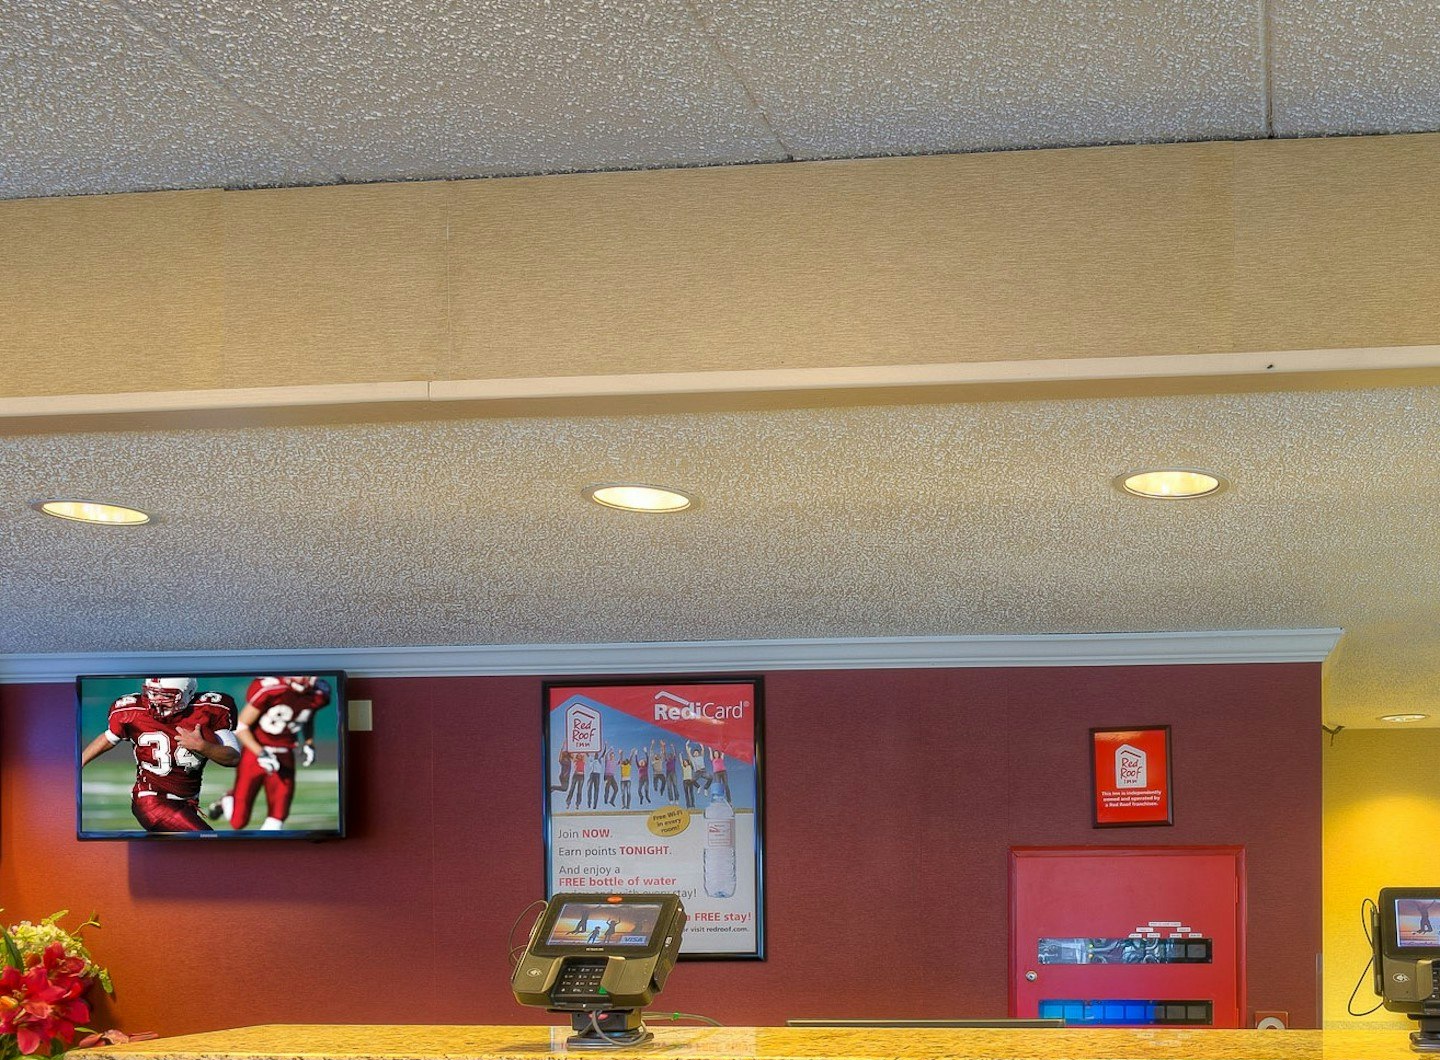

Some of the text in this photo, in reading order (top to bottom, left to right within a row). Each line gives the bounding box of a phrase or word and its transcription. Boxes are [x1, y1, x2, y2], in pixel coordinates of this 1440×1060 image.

[573, 718, 592, 730] Red
[572, 728, 596, 742] Roof
[1122, 758, 1138, 768] Red
[1120, 766, 1143, 780] Roof
[558, 829, 613, 839] Join NOW.
[558, 845, 672, 857] Earn points TONIGHT.
[559, 865, 620, 877] And enjoy a
[559, 876, 677, 887] FREE bottle of water
[694, 912, 721, 922] FREE
[723, 911, 752, 923] stay!
[690, 925, 705, 933] visit
